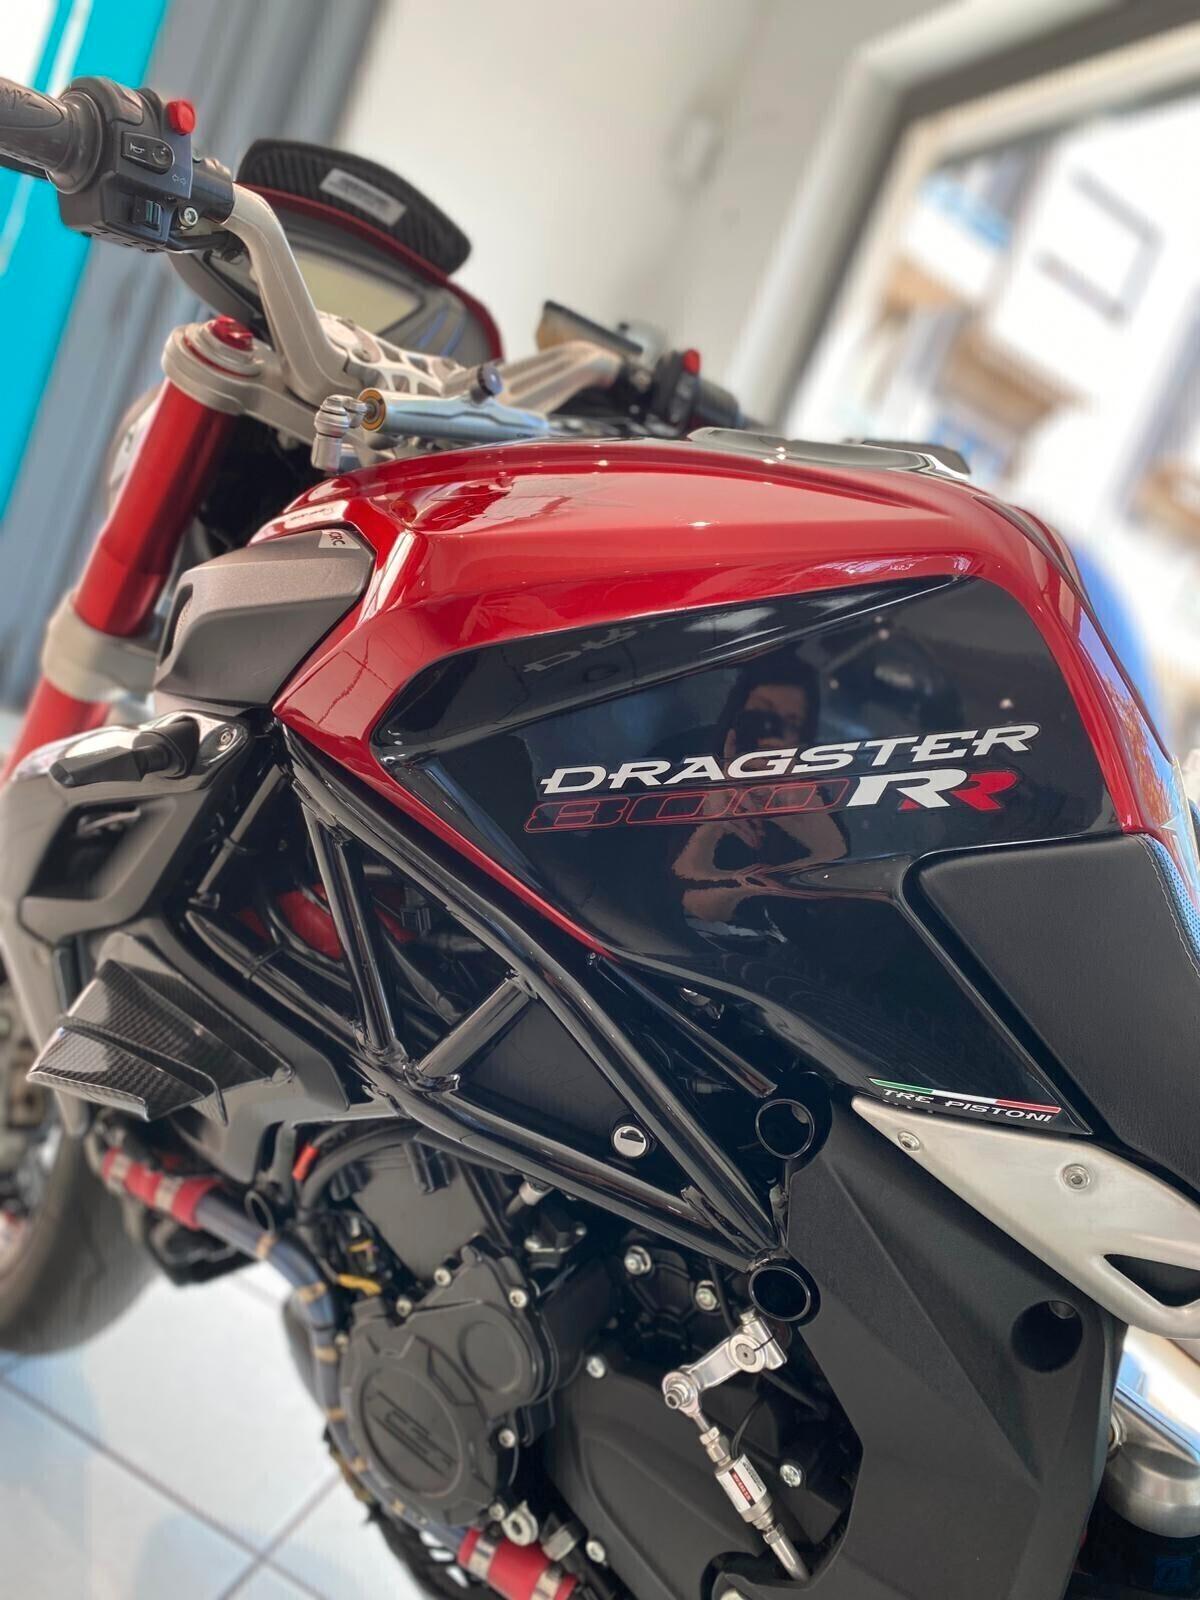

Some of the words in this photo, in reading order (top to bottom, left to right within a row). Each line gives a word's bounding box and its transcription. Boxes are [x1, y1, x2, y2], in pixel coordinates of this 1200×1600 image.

[540, 724, 1040, 794] DRAGSTER
[883, 1088, 935, 1104] TRE
[944, 1100, 1053, 1124] PISTONI
